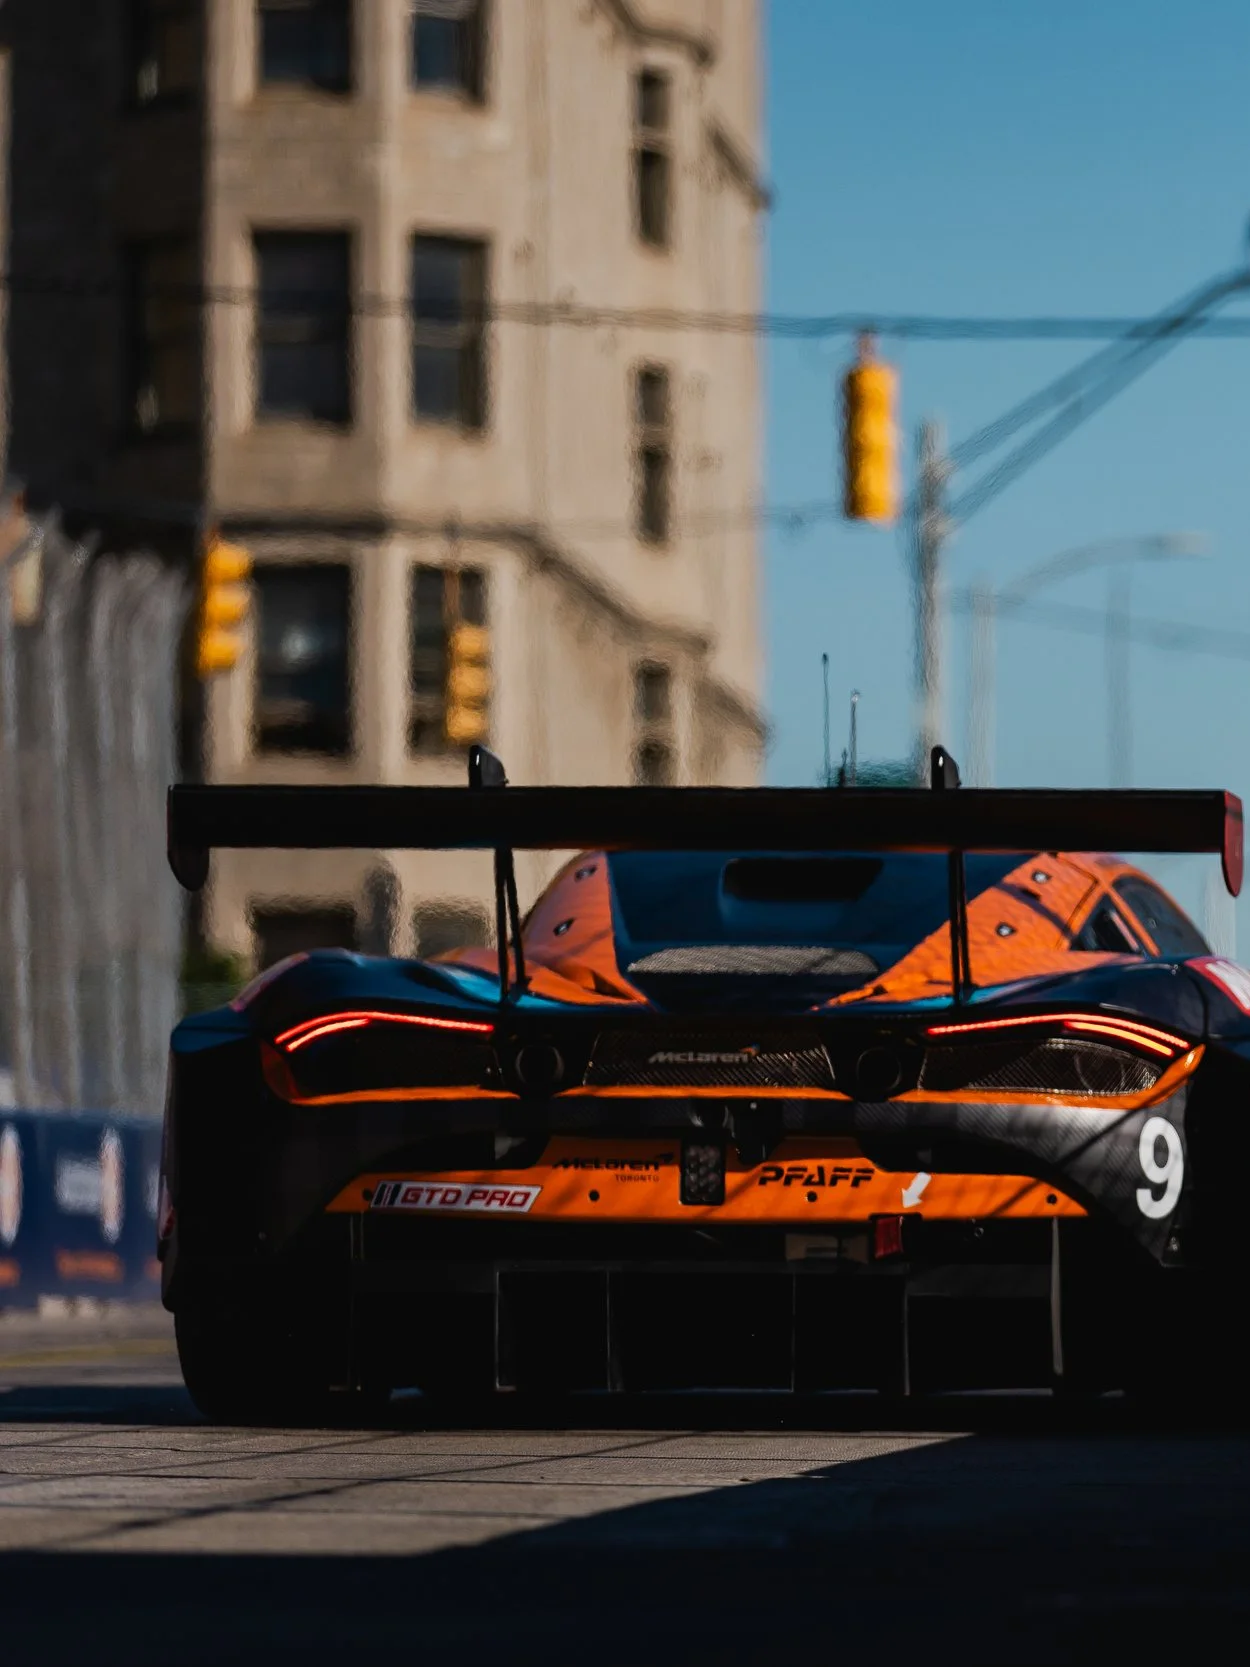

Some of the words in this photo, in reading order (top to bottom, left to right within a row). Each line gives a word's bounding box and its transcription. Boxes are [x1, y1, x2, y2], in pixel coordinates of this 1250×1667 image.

[647, 1050, 749, 1064] McLaren
[616, 1174, 659, 1183] TORONTO
[758, 1165, 875, 1188] PFAFF
[1136, 1116, 1184, 1220] 9
[400, 1187, 462, 1206] GTD
[465, 1189, 532, 1208] PRO
